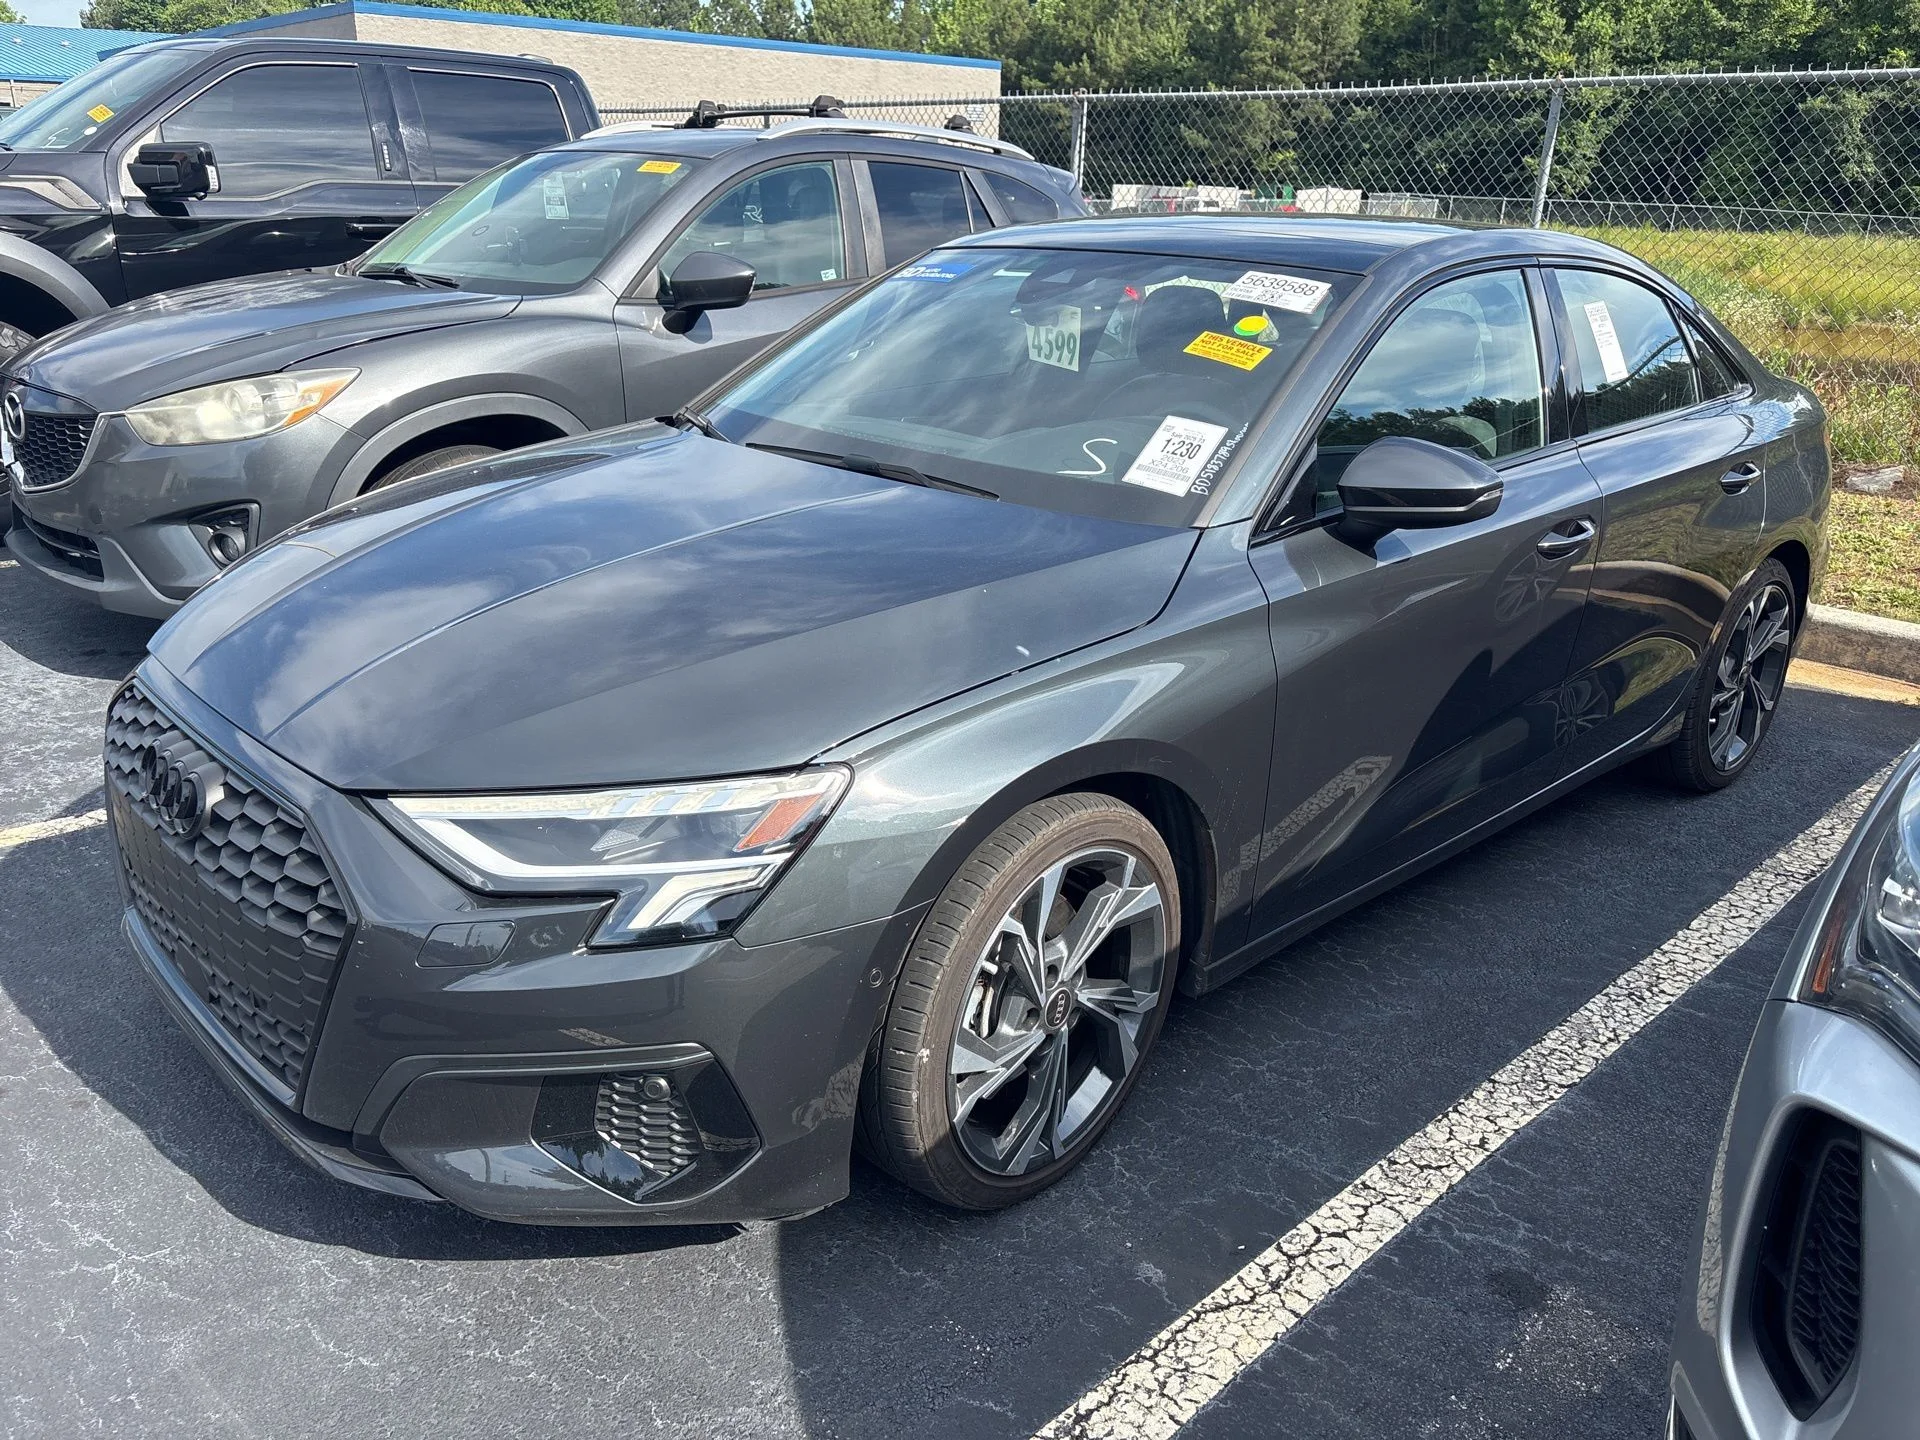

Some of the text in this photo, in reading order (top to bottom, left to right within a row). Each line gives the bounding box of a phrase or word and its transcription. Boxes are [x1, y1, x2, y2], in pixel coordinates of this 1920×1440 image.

[1242, 274, 1319, 296] 5639588
[1031, 325, 1077, 366] 4599
[1199, 339, 1258, 358] NOT FOR SALE
[1203, 333, 1224, 342] THIS
[1226, 337, 1265, 354] VEHICLE
[1160, 437, 1202, 460] 1:230
[1161, 454, 1186, 465] 2023
